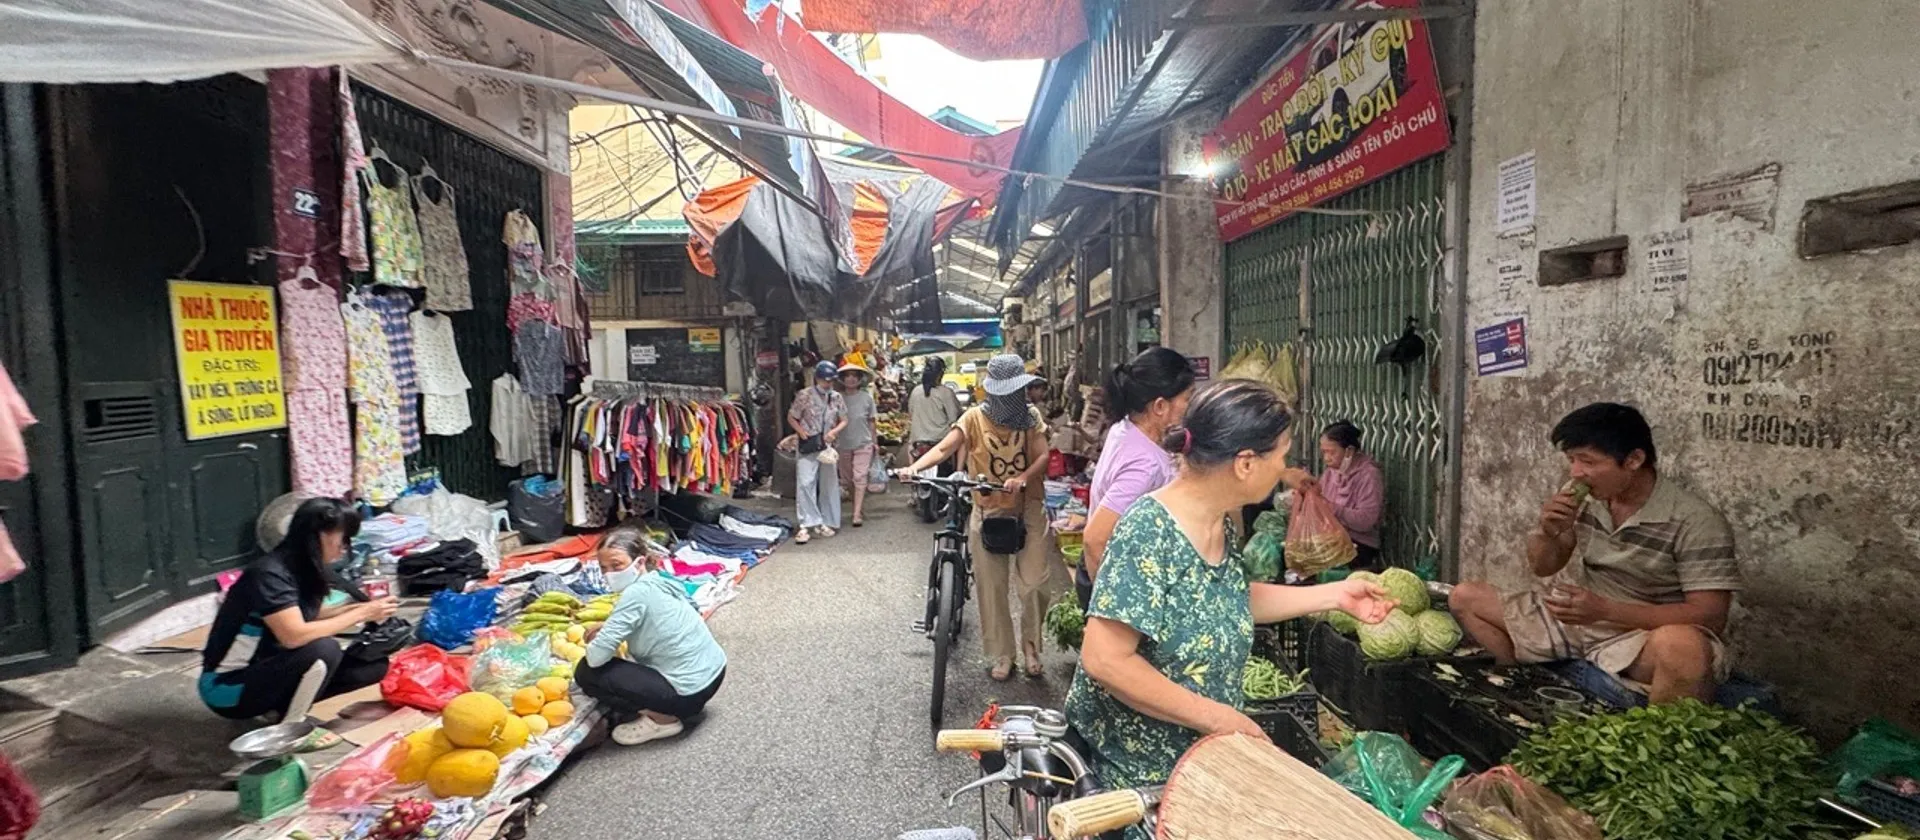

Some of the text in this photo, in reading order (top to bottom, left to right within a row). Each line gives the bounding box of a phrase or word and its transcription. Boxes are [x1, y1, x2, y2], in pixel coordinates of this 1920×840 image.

[1255, 158, 1271, 184] XE
[1272, 131, 1304, 173] MÁY
[1306, 112, 1344, 154] CÁC
[1349, 79, 1398, 130] LOẠI
[1260, 101, 1294, 140] TRAO
[1339, 35, 1364, 86] KÝ
[1290, 172, 1307, 191] CÁC
[1327, 159, 1334, 172] &
[1335, 145, 1361, 169] SANG
[1362, 134, 1381, 156] TÊN
[1383, 116, 1406, 144] ĐỔI
[1408, 101, 1438, 133] CHỦ
[180, 292, 270, 320] NHÀ THUỐC
[184, 322, 275, 352] GIA TRUYỀN
